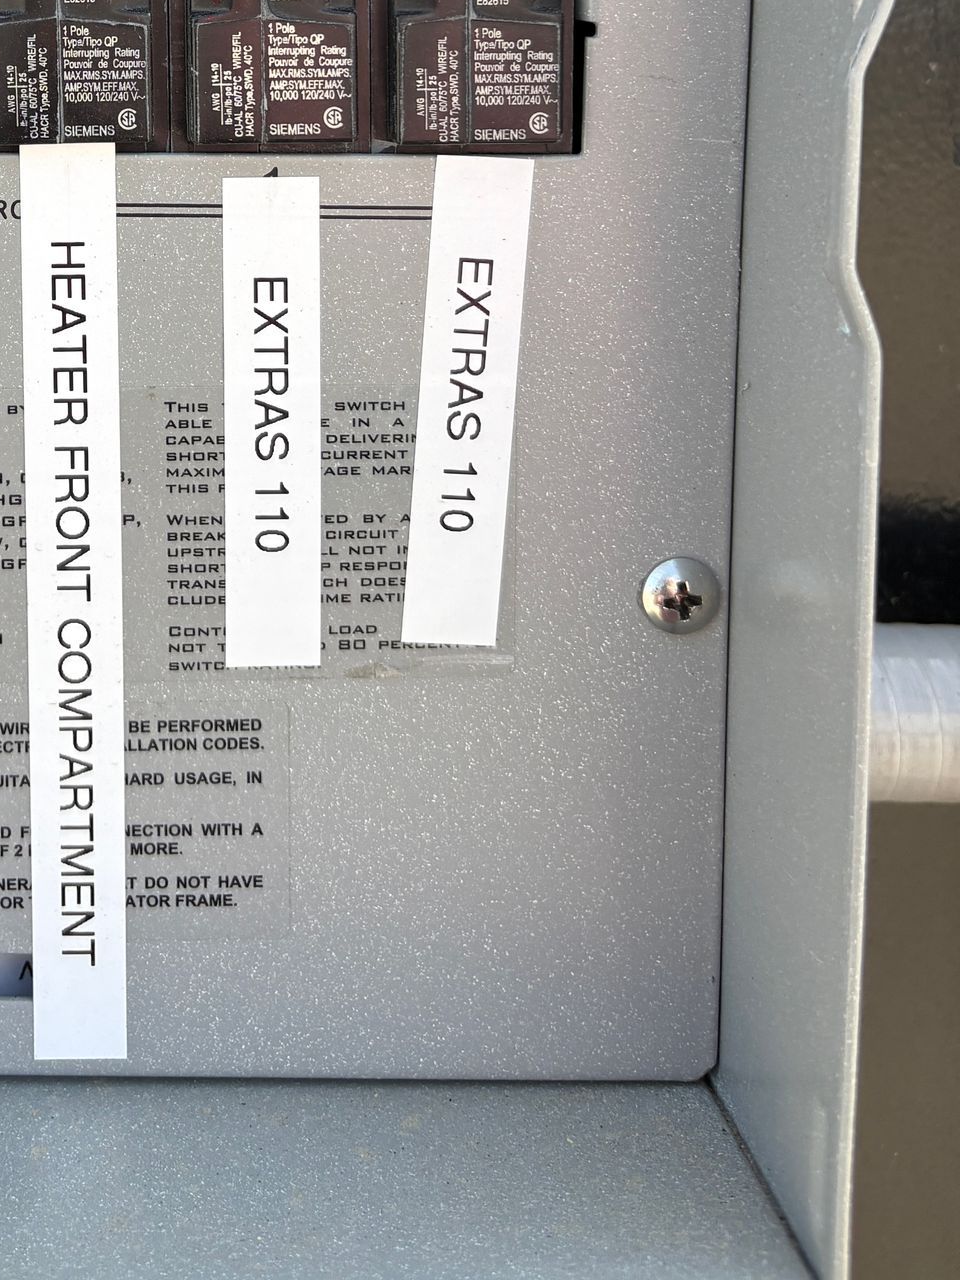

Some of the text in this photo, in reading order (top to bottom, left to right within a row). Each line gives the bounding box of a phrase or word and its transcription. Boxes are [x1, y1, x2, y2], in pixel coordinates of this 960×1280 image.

[65, 125, 115, 136] SIEMENS
[270, 124, 320, 135] SIEMENS
[475, 129, 526, 141] SIEMENS
[440, 258, 493, 532] EXTRAS 110
[335, 402, 405, 410] SWITCH
[254, 278, 289, 552] EXTRAS 110
[165, 418, 369, 429] ABLE IN
[321, 450, 408, 459] CURRENT
[364, 514, 386, 523] BY
[326, 530, 398, 539] CIRCUIT
[349, 546, 386, 555] NOT
[51, 242, 95, 966] HEATER FRONT COMPARTMENT
[329, 625, 377, 634] LOAD
[169, 640, 365, 652] NOT 80
[129, 721, 150, 733] BE
[158, 719, 261, 732] PERFORMED
[203, 737, 264, 750] CODES.
[175, 772, 236, 786] USAGE,
[247, 772, 261, 783] IN
[202, 824, 242, 836] WITH
[252, 823, 263, 835] A
[15, 845, 22, 856] 2
[131, 843, 182, 855] MORE.
[145, 877, 168, 889] DO
[177, 876, 210, 888] NOT
[219, 876, 263, 888] HAVE
[0, 897, 24, 909] OR
[176, 894, 237, 907] FRAME.
